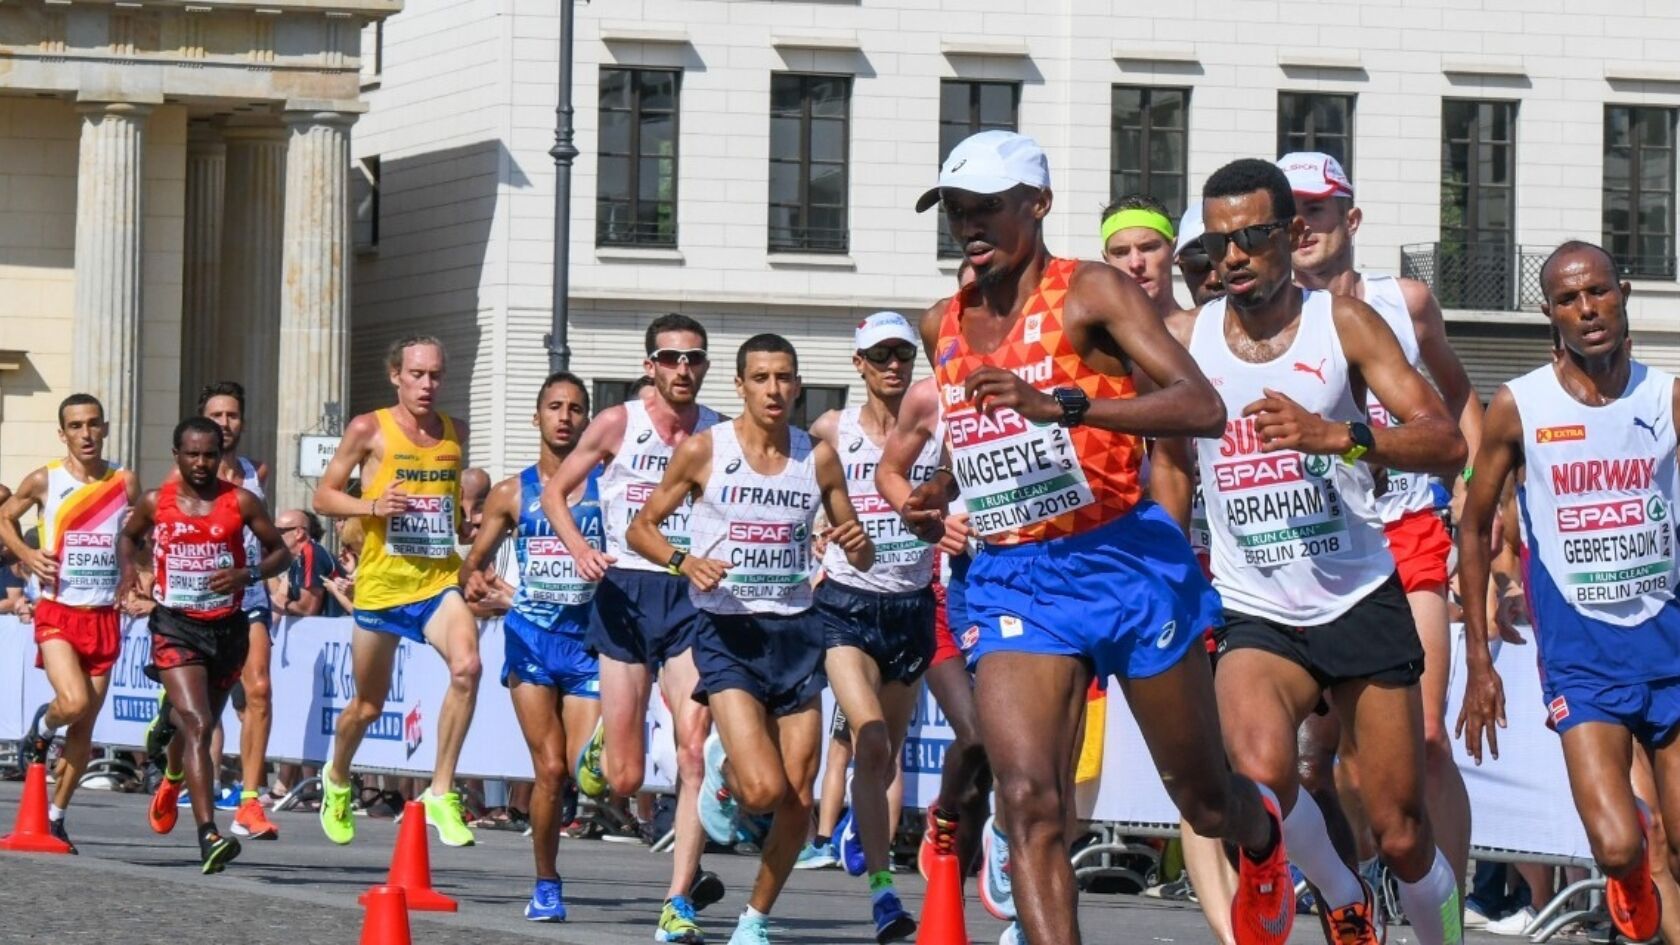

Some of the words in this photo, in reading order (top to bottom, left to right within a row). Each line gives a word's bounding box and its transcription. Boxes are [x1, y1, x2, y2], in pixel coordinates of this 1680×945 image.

[950, 408, 1023, 444] SPAR
[1052, 429, 1072, 470] 273
[957, 439, 1051, 488] NAGEEYE
[1217, 458, 1300, 488] SPAR
[396, 469, 457, 482] SWEDEN
[1551, 458, 1655, 495] NORWAY
[986, 494, 1010, 506] RUN
[1011, 484, 1049, 501] CLEAN
[1387, 478, 1408, 493] 018
[406, 498, 441, 510] PAR
[739, 487, 811, 509] FRANCE
[1226, 487, 1323, 526] ABRAHAM
[975, 505, 1031, 532] BERLIN
[1034, 490, 1081, 518] 2018
[1560, 503, 1642, 529] SPAR
[391, 516, 446, 533] EKVALL
[731, 524, 791, 541] SPAR
[66, 533, 112, 547] SPAR
[1252, 533, 1277, 544] RUN
[1280, 526, 1316, 541] CLEAN
[1661, 523, 1671, 557] 274
[393, 545, 428, 554] BERLIN
[529, 542, 571, 554] SPA
[1300, 537, 1339, 557] 2018
[1564, 530, 1658, 564] GEBRETSADIK
[68, 552, 116, 566] ESPAÑA
[168, 559, 215, 571] SPAR
[731, 548, 796, 569] CHAHDI
[70, 577, 99, 586] BERLIN
[1596, 570, 1617, 580] RUN
[1620, 567, 1649, 578] CLEAN
[533, 590, 568, 602] BERLIN
[732, 585, 774, 597] BERLIN
[1577, 585, 1630, 601] BERLIN
[1635, 575, 1667, 595] 2018
